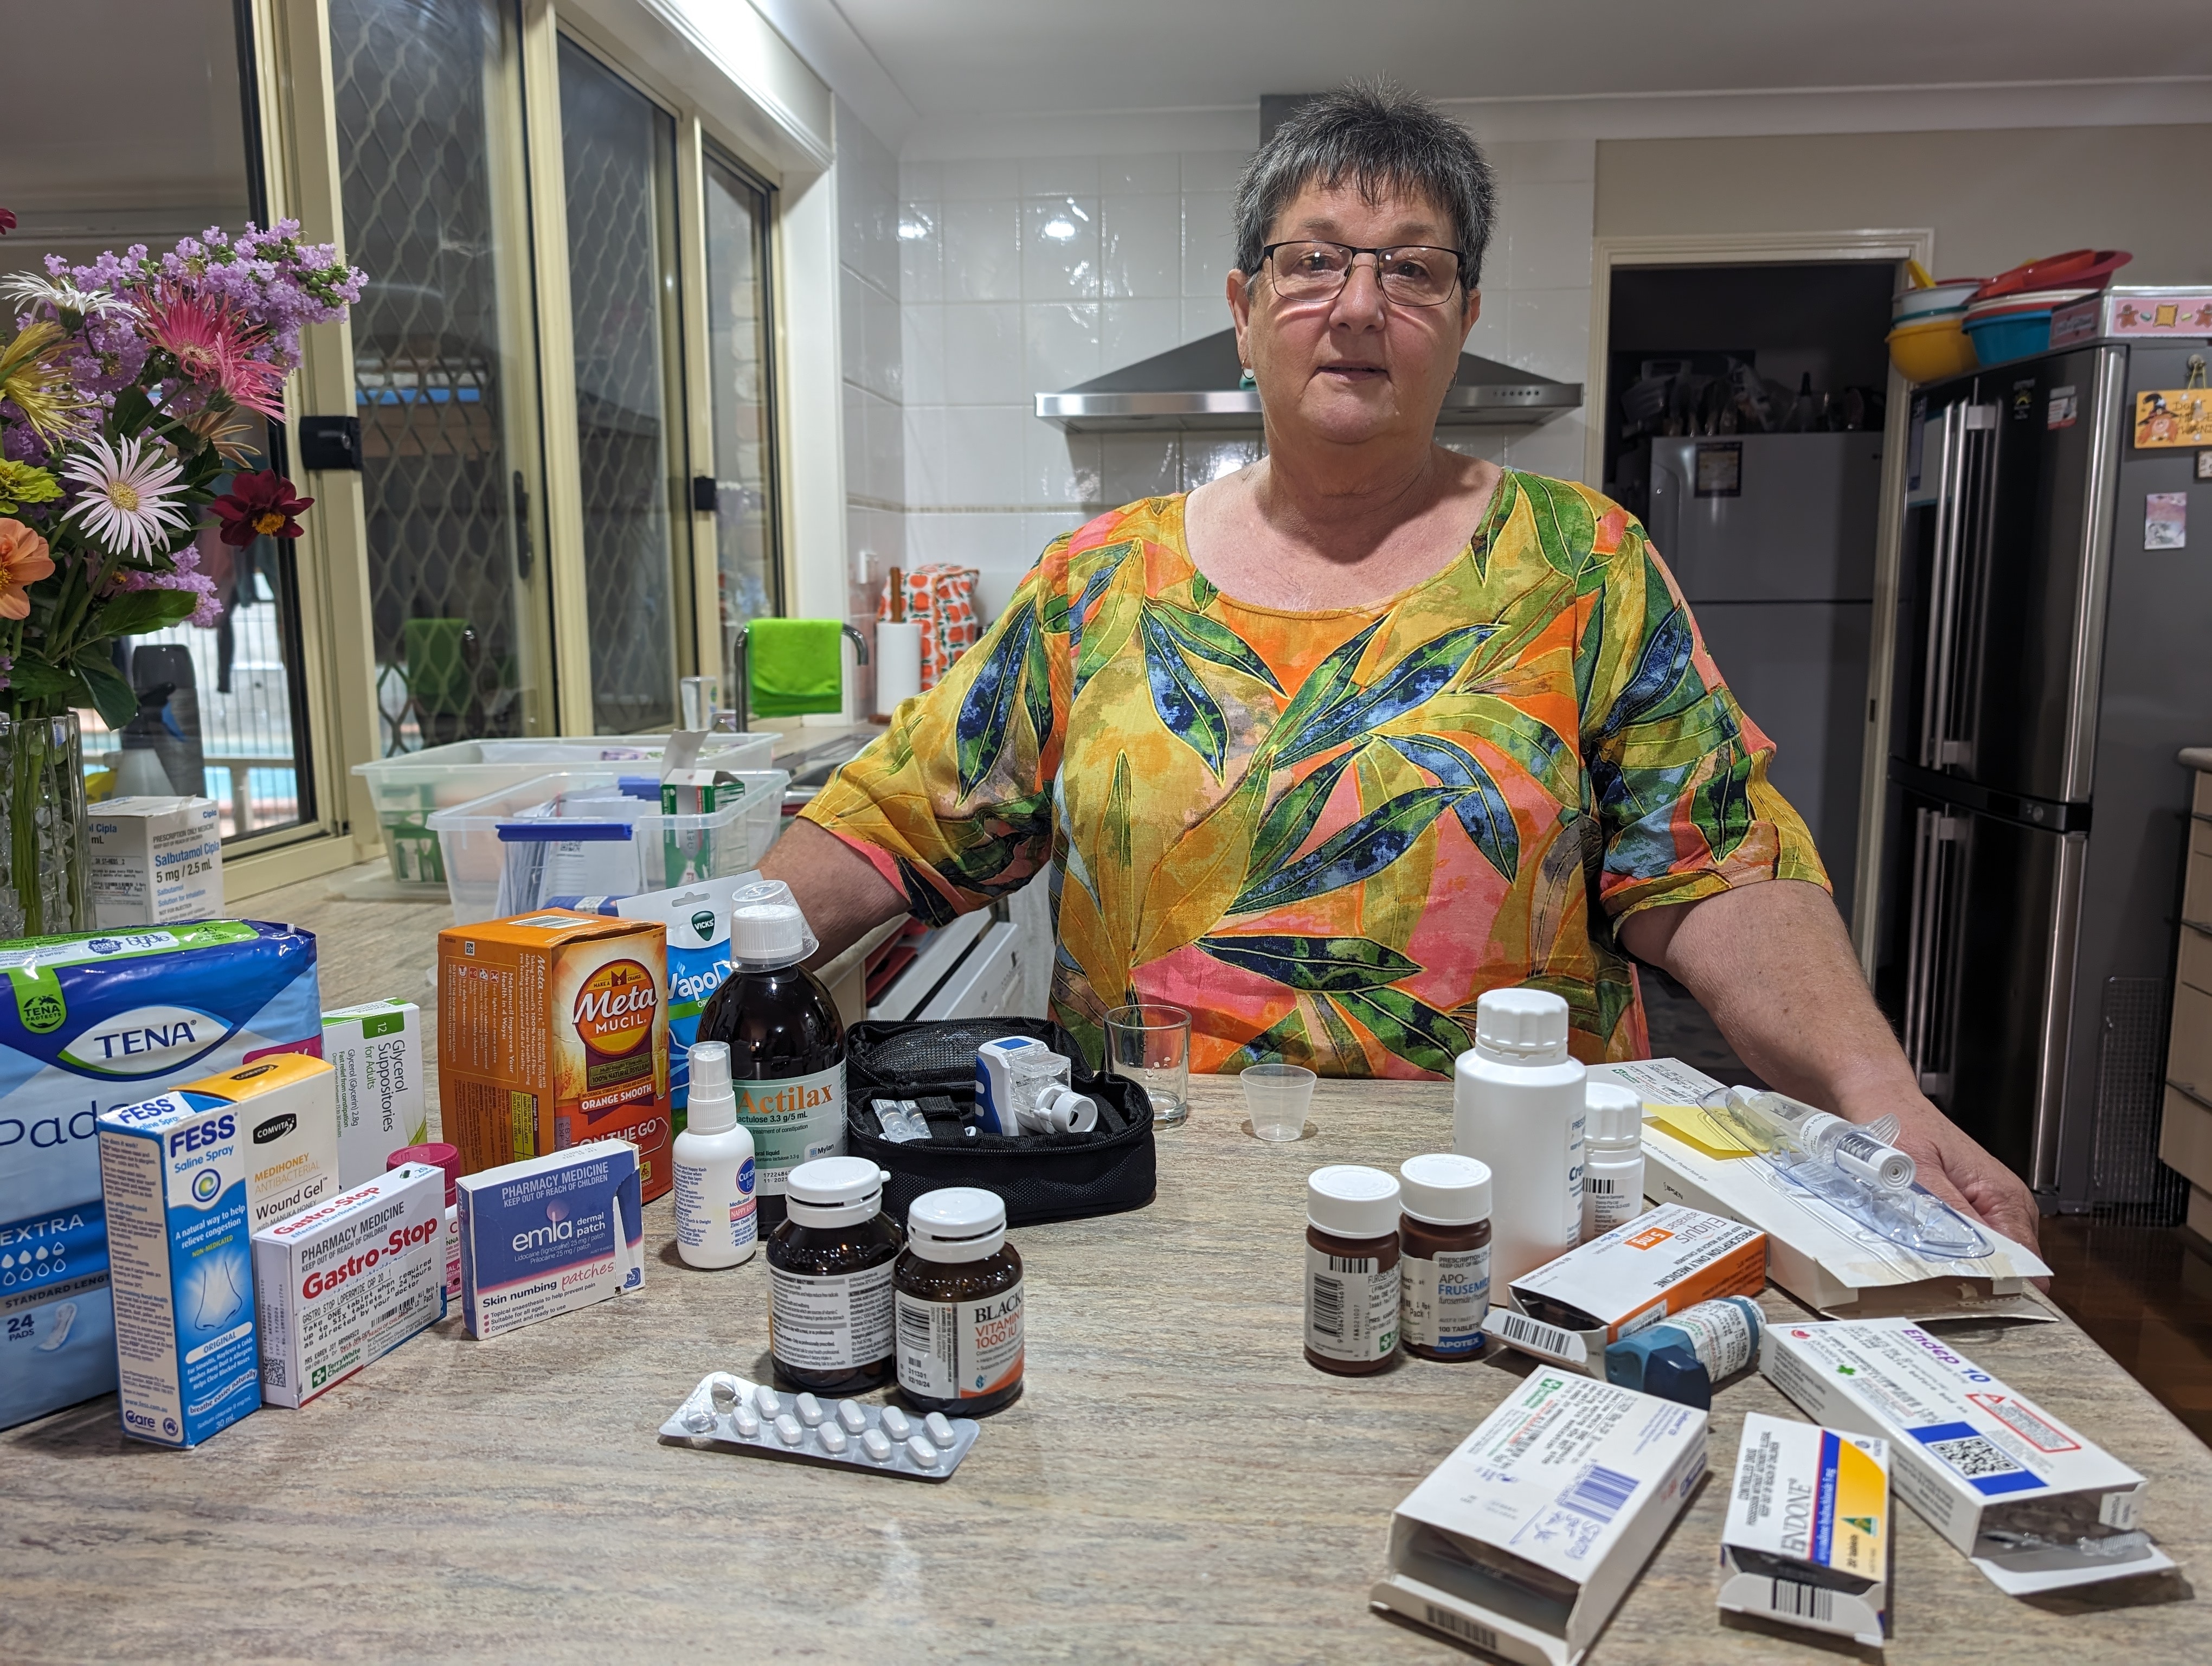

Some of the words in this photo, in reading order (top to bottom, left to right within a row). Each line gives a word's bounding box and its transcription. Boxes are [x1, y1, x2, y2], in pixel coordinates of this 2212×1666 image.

[203, 810, 217, 818] Cipla
[97, 824, 117, 834] Cipla
[153, 829, 186, 843] PRESCRIPTION
[187, 826, 197, 835] ONLY
[198, 823, 214, 832] MEDICINE
[155, 845, 202, 867] Salbutamol
[204, 841, 220, 855] Cipla
[157, 872, 162, 883] 5
[165, 870, 179, 881] mg
[182, 866, 185, 877] /
[188, 864, 200, 876] 2.5
[201, 859, 213, 872] mL
[157, 885, 184, 896] Salbutamol
[158, 895, 178, 907] Solution
[23, 1004, 61, 1014] TENA
[572, 985, 657, 1024] Meta
[25, 1013, 62, 1021] PROTECTS
[378, 1022, 387, 1033] 12
[348, 1049, 357, 1078] Glycerol
[365, 1046, 375, 1059] for
[235, 1066, 268, 1081] COMVITA
[366, 1061, 377, 1090] Adults
[393, 1040, 408, 1093] Glycerol
[592, 1074, 607, 1083] 100%
[609, 1069, 629, 1079] NATURAL
[630, 1063, 649, 1074] PSYLLIUM
[350, 1077, 359, 1110] (Glycerin)
[378, 1042, 395, 1132] Suppositories
[582, 1093, 619, 1110] ORANGE
[620, 1084, 652, 1101] SMOOTH
[737, 1084, 833, 1113] Actilax
[351, 1111, 359, 1126] 2.8g
[783, 1113, 795, 1122] g/5
[256, 1121, 290, 1139] COMVITA
[607, 1126, 636, 1140] THE
[638, 1119, 656, 1137] GO
[174, 1152, 204, 1173] Saline
[205, 1145, 234, 1166] Spray
[818, 1144, 834, 1155] Mylan
[255, 1153, 310, 1183] MEDIHONEY
[255, 1161, 320, 1195] ANTIBACTERIAL
[502, 1174, 558, 1200] PHARMACY
[562, 1162, 609, 1182] MEDICINE
[1667, 1185, 1683, 1200] IPSEN
[256, 1189, 300, 1220] Wound
[274, 1187, 381, 1235] Gastro-Stop
[729, 1196, 750, 1207] Medicated
[731, 1208, 746, 1218] NAPPY
[176, 1231, 182, 1241] A
[183, 1220, 207, 1239] natural
[208, 1216, 220, 1233] way
[221, 1212, 228, 1222] to
[229, 1204, 246, 1221] help
[257, 1222, 270, 1232] with
[271, 1209, 296, 1226] MANUKA
[297, 1200, 317, 1213] HONEY
[291, 1221, 323, 1238] Effective
[324, 1205, 357, 1223] Diarrhoea
[357, 1195, 377, 1208] Relief
[577, 1213, 604, 1226] dermal
[1663, 1211, 1701, 1231] apixaban
[1, 1214, 84, 1246] EXTRA
[181, 1233, 203, 1248] relieve
[204, 1218, 241, 1241] congestion
[301, 1227, 357, 1264] PHARMACY
[360, 1201, 405, 1232] MEDICINE
[512, 1215, 572, 1251] emla
[577, 1221, 605, 1238] patch
[1631, 1235, 1654, 1246] mg
[1653, 1229, 1667, 1238] 5
[1675, 1217, 1727, 1244] Eliquis
[191, 1234, 233, 1257] NON-MEDICATED
[301, 1260, 316, 1273] KEEP
[317, 1255, 327, 1266] OUT
[329, 1252, 336, 1261] OF
[337, 1244, 354, 1258] REACH
[355, 1240, 362, 1249] OF
[363, 1223, 388, 1246] CHILDREN
[1710, 1228, 1757, 1257] PRESCRIPTION
[302, 1218, 438, 1300] Gastro-Stop
[1439, 1254, 1480, 1263] PRESCRIPTION
[1691, 1254, 1711, 1268] ONLY
[483, 1292, 507, 1308] Skin
[510, 1279, 557, 1300] numbing
[562, 1261, 614, 1291] patches
[1439, 1274, 1468, 1284] APO-
[1654, 1263, 1692, 1287] MEDICINE
[5, 1285, 70, 1308] STANDARD
[303, 1319, 323, 1334] Take
[327, 1308, 342, 1321] ONE
[347, 1291, 373, 1309] tablet
[378, 1280, 395, 1292] when
[399, 1264, 430, 1280] required
[491, 1308, 511, 1318] Topical
[512, 1298, 544, 1311] anaesthesia
[551, 1292, 563, 1300] help
[564, 1286, 582, 1298] prevent
[583, 1280, 596, 1289] pain
[7, 1314, 34, 1333] 24
[975, 1312, 1019, 1337] VITAMIN
[1410, 1309, 1423, 1318] Pack
[9, 1329, 34, 1342] PADS
[975, 1331, 1006, 1349] 1000
[1008, 1324, 1017, 1337] IU
[1452, 1322, 1479, 1332] TABLETS
[204, 1331, 236, 1353] ORIGINAL
[1438, 1336, 1479, 1348] APOTEX
[328, 1348, 361, 1371] TerryWhite
[1901, 1329, 1960, 1366] Endep
[1960, 1368, 1991, 1383] 10
[190, 1400, 213, 1413] breathe
[214, 1386, 230, 1402] easier
[232, 1370, 255, 1389] naturally
